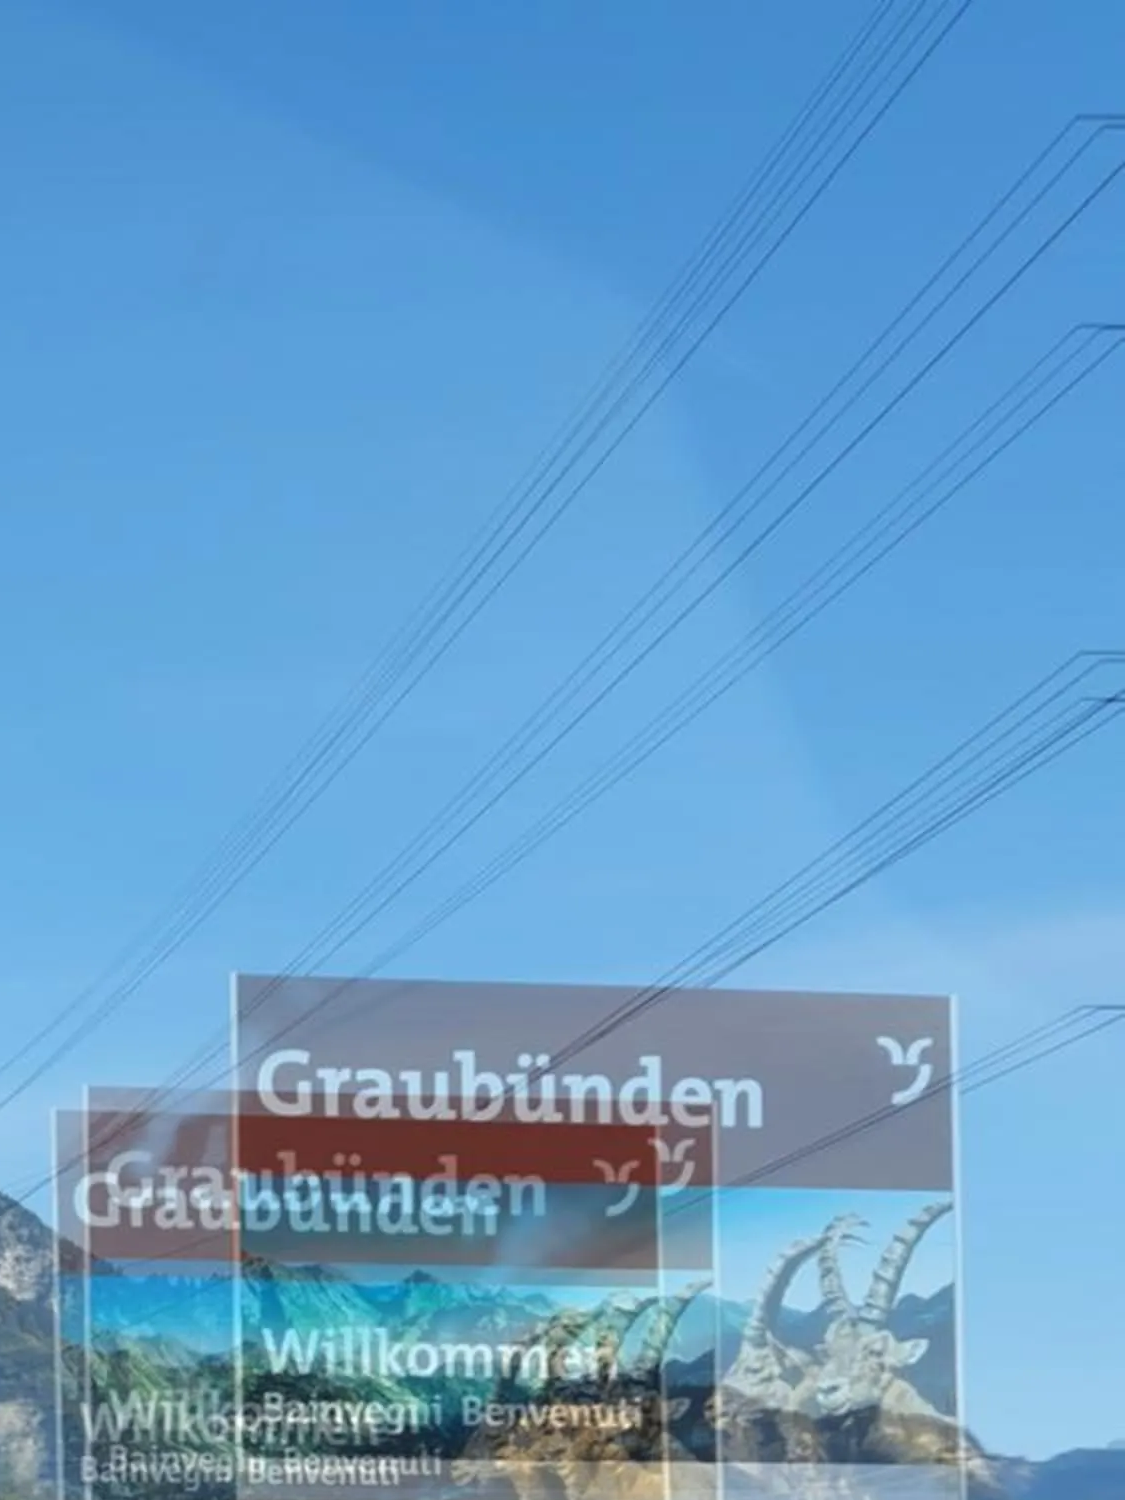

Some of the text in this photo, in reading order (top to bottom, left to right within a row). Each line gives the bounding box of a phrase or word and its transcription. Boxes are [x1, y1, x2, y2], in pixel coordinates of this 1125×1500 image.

[256, 1049, 763, 1128] Graubünden
[74, 1170, 498, 1237] Graubünden
[106, 1150, 546, 1216] Graubünden
[262, 1327, 618, 1381] Willkommen
[462, 1394, 642, 1430] Benvenuti
